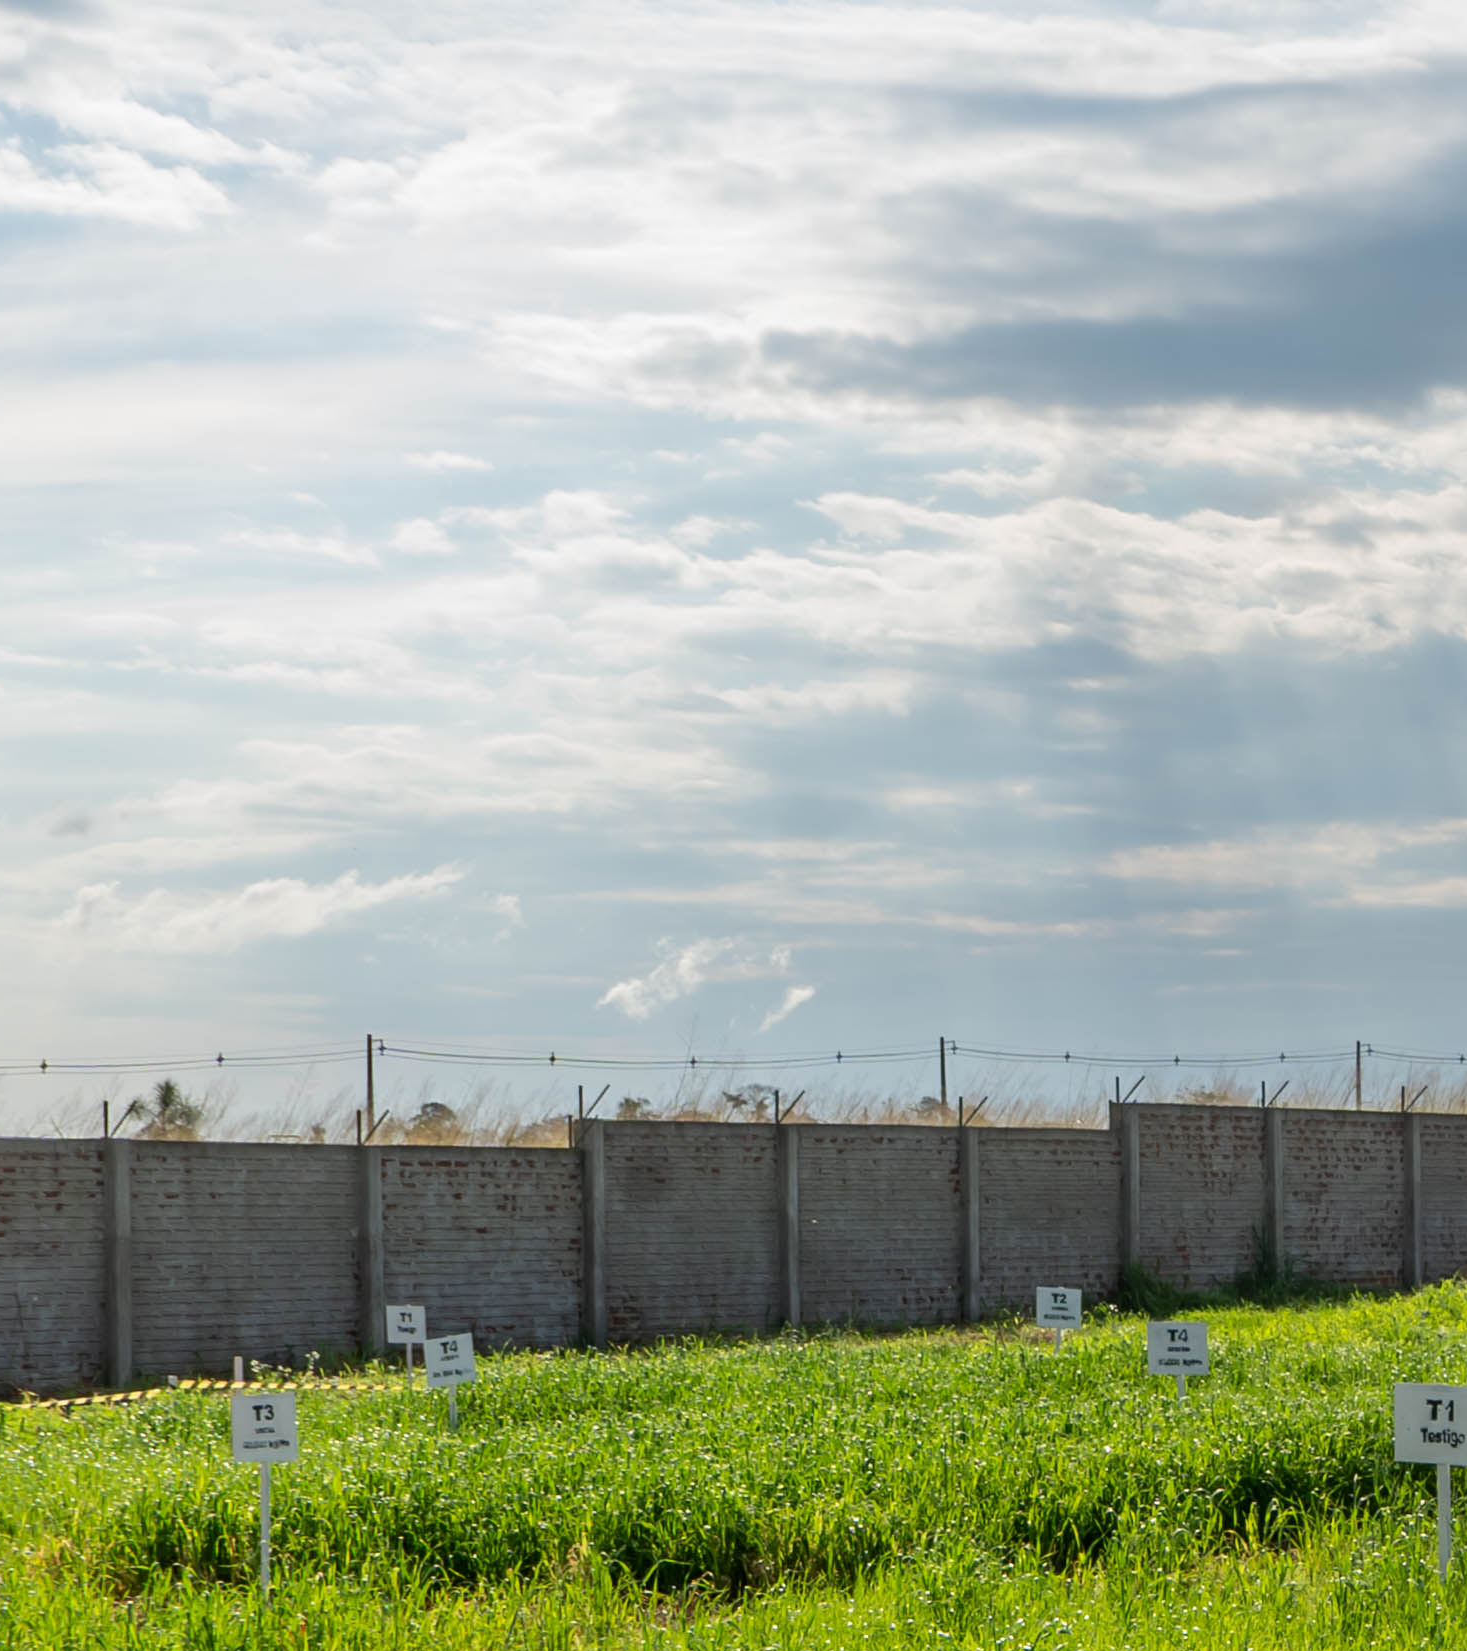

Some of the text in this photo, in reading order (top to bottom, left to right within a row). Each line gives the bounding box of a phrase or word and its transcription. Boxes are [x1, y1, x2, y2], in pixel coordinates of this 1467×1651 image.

[1051, 1293, 1067, 1304] T2
[1167, 1329, 1188, 1342] T4
[440, 1341, 458, 1354] T4
[252, 1404, 274, 1421] T3
[1426, 1399, 1454, 1422] T1
[1420, 1427, 1465, 1448] Testigo
